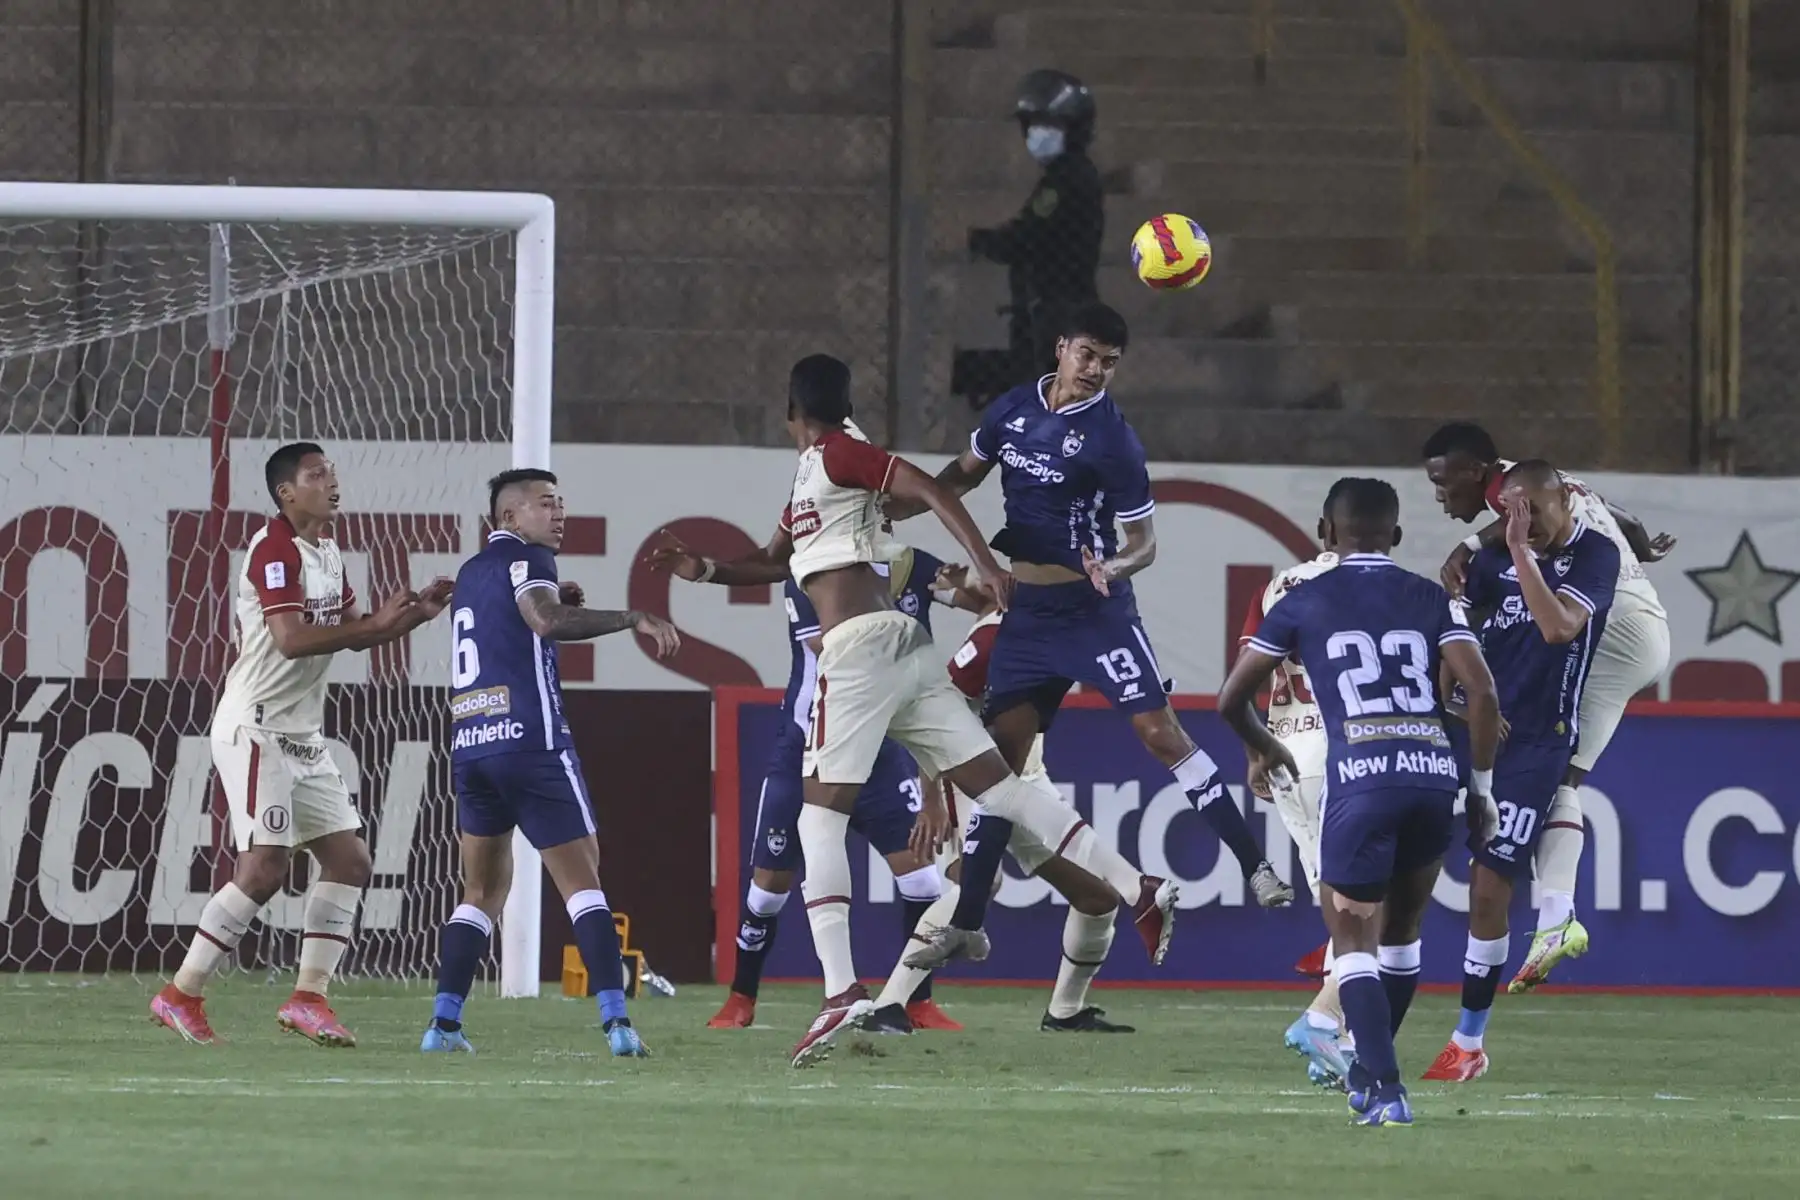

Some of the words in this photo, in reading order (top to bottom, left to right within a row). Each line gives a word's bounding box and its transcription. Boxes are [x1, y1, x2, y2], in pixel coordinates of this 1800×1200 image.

[451, 606, 480, 689] 6
[1095, 646, 1142, 684] 13
[1326, 629, 1436, 717] 23
[455, 718, 524, 751] Athletic
[1338, 755, 1388, 784] New
[1395, 750, 1459, 780] Athleti
[1498, 800, 1538, 846] 30
